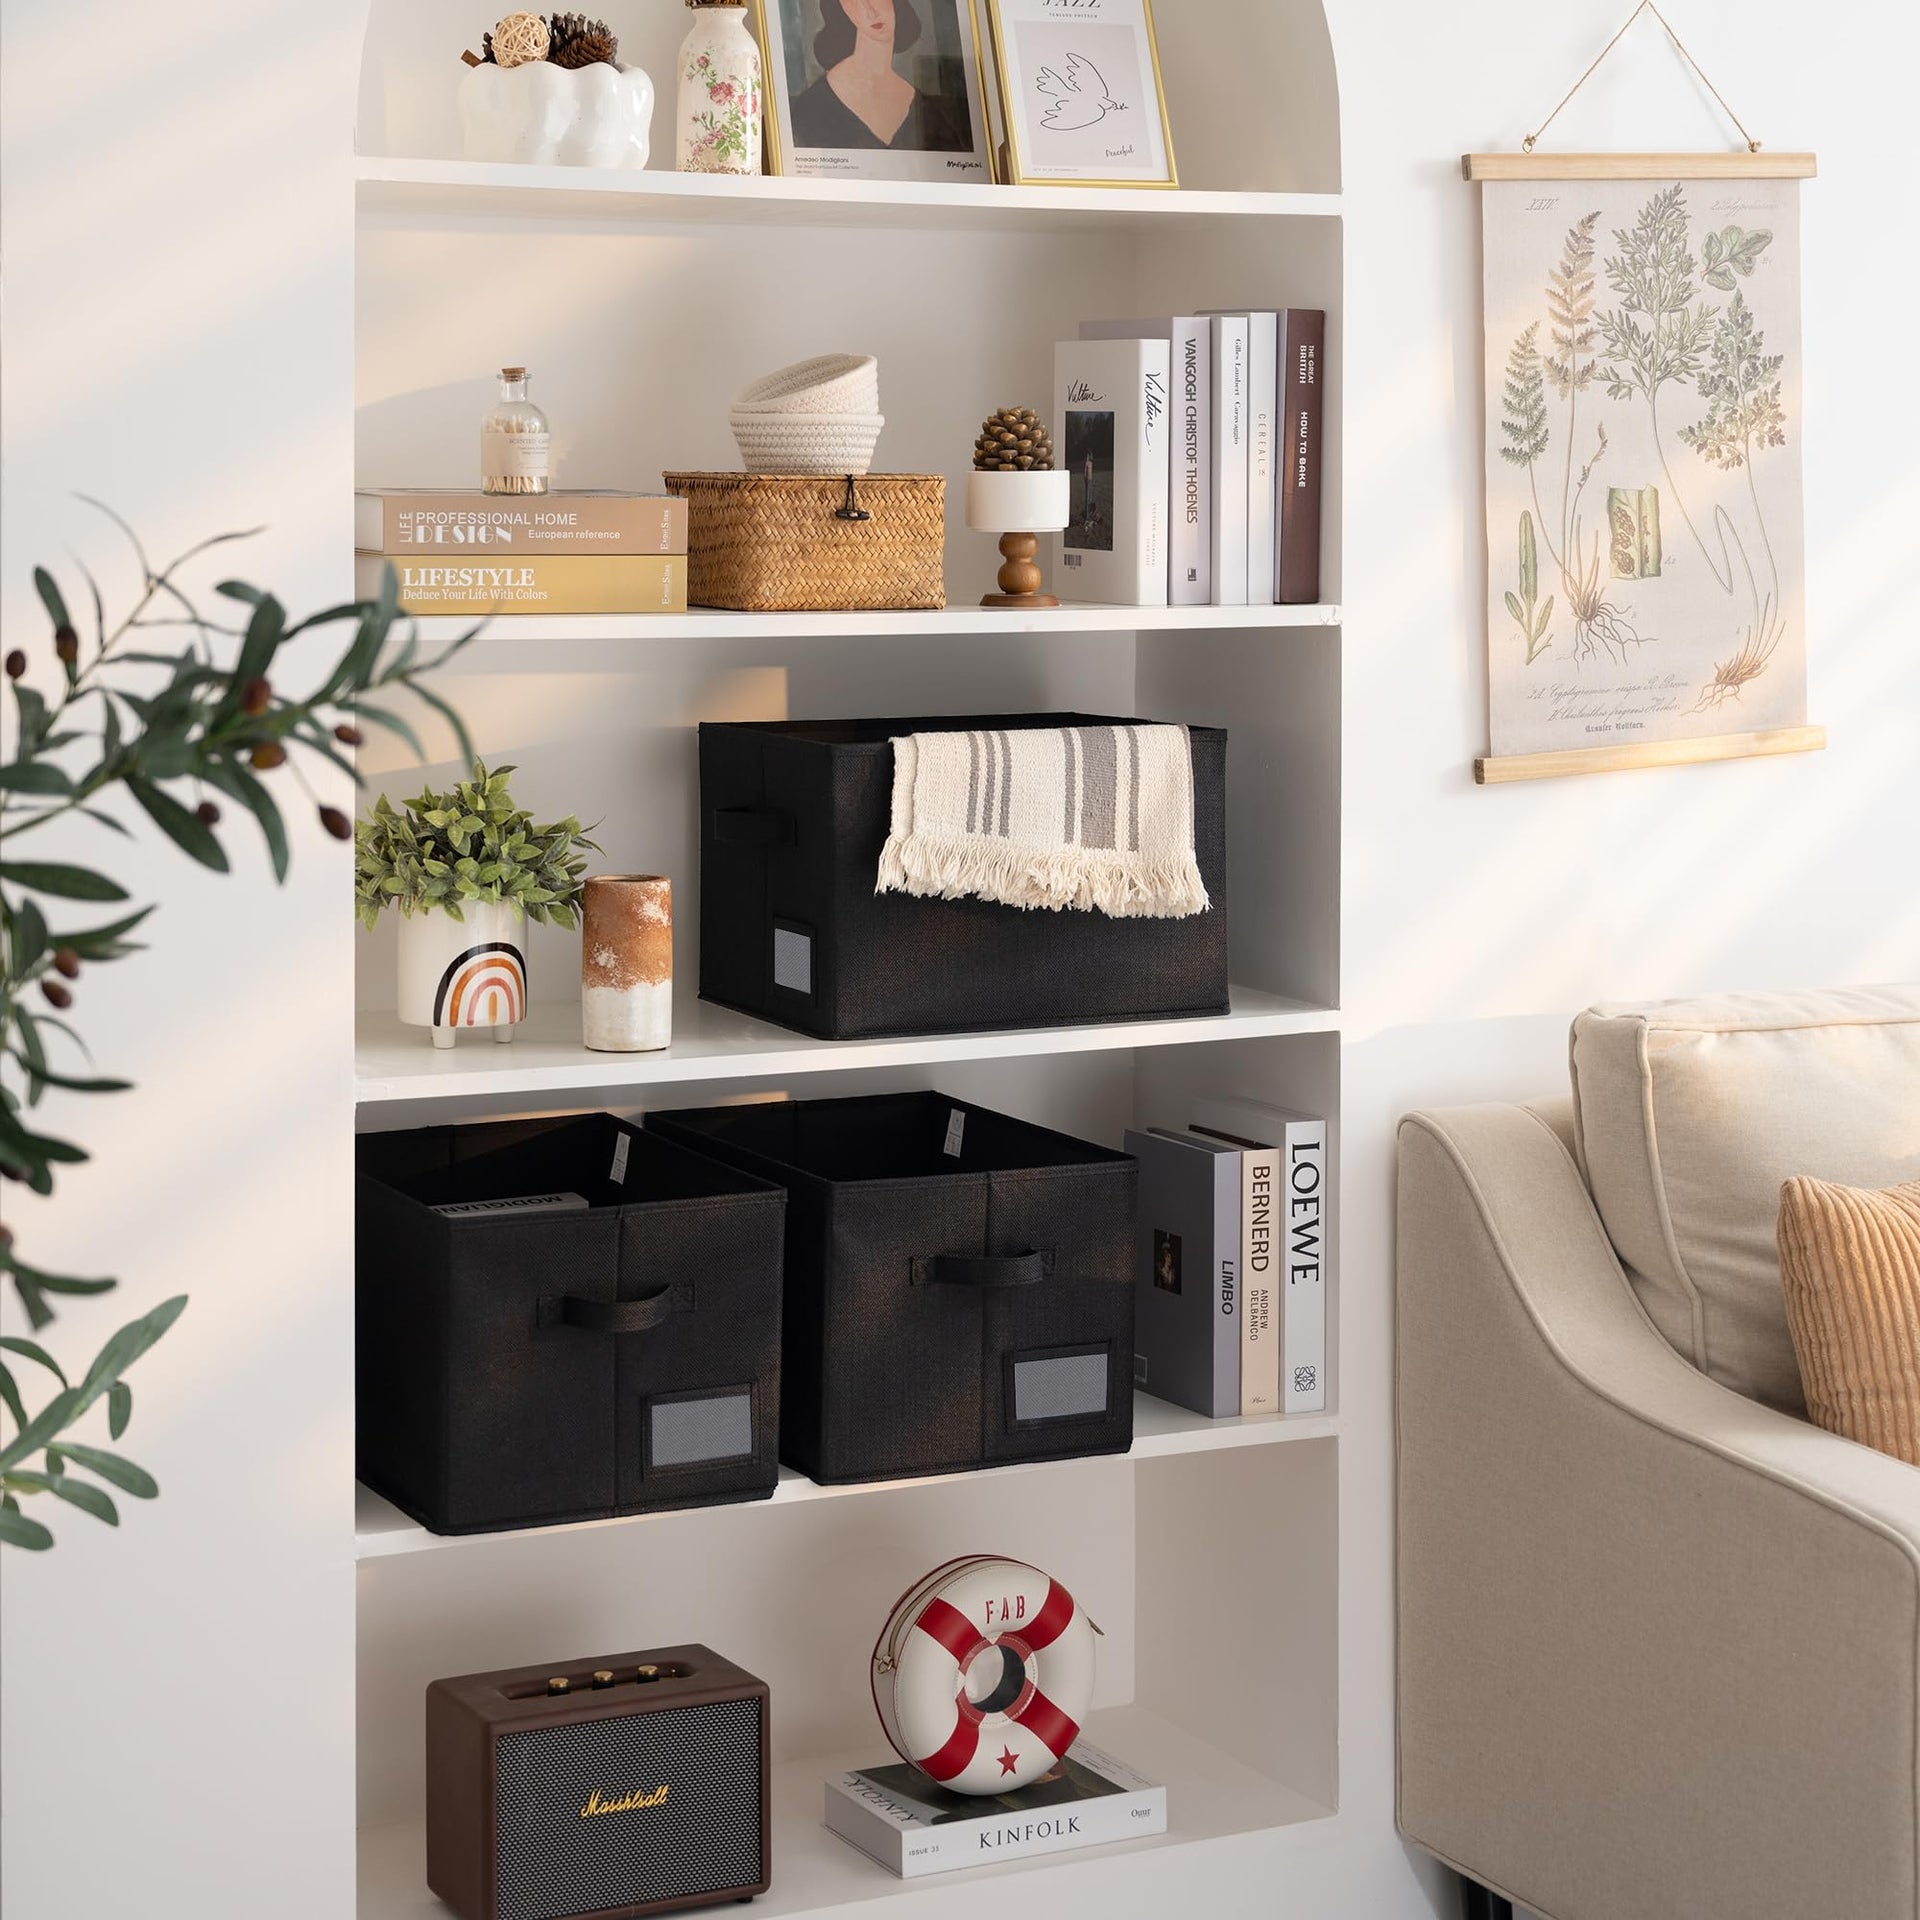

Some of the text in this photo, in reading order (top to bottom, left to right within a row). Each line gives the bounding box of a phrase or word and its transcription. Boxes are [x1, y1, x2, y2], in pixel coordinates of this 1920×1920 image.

[1299, 344, 1307, 385] BRITISH
[1307, 345, 1315, 385] THE GREAT
[1144, 372, 1166, 448] Vulture
[1232, 338, 1242, 446] Gilles Lambert Caravaggio
[1184, 337, 1198, 524] VANGOGH CHRISTOF THOENES
[1257, 413, 1267, 463] CEREAL
[1298, 411, 1308, 489] HOW TO BAKE
[399, 511, 412, 544] LIFE
[416, 511, 577, 526] PROFESSIONAL HOME
[416, 525, 512, 544] DESIGN
[528, 529, 621, 541] European reference
[403, 567, 536, 587] LIFESTYLE
[403, 588, 548, 600] Deduce Your Life With Colors
[1251, 1165, 1271, 1272] BERNERD
[1291, 1141, 1320, 1285] LOEWE
[1221, 1260, 1234, 1316] LIMBO
[1249, 1289, 1259, 1342] DELBANCO
[1259, 1288, 1269, 1330] ANDREW
[985, 1595, 1026, 1624] FAB
[908, 1847, 929, 1857] ISSUE
[979, 1815, 1081, 1849] KINFOLK
